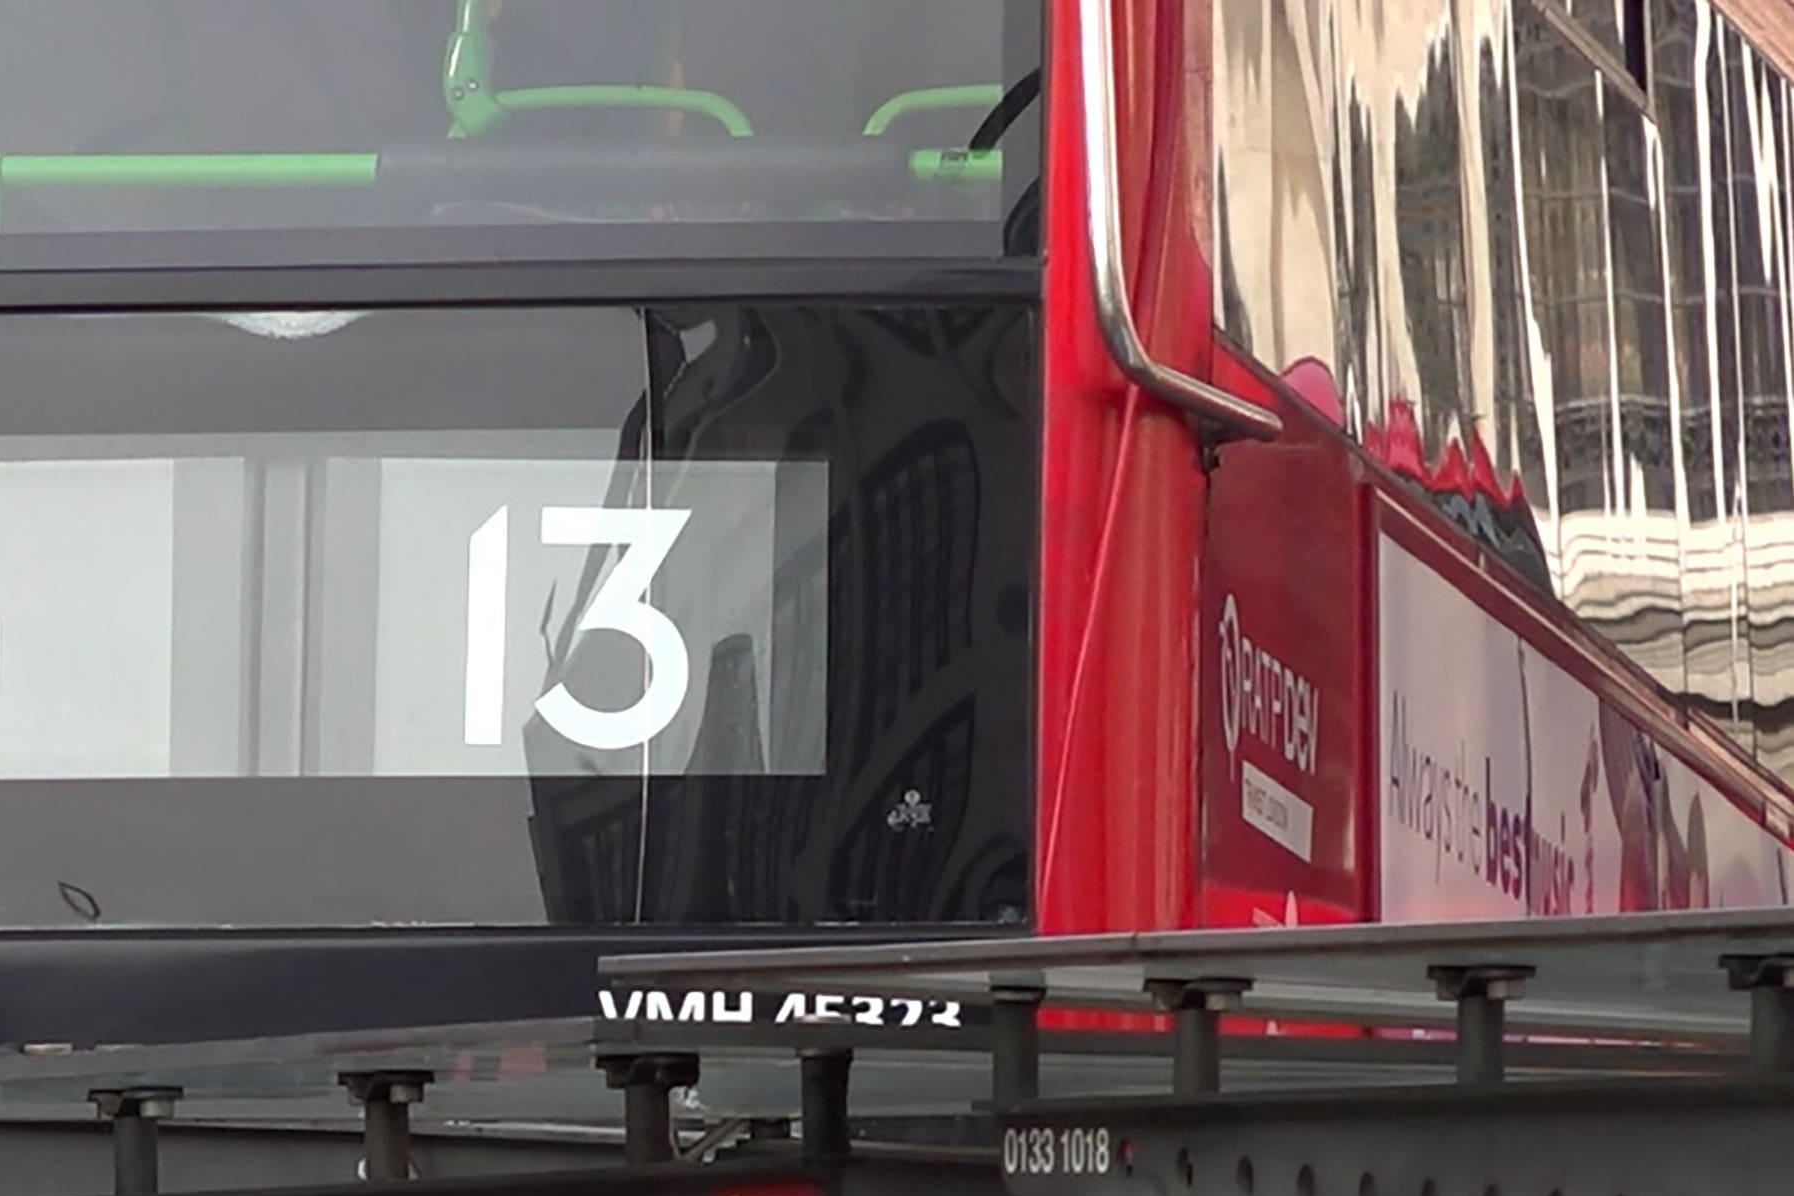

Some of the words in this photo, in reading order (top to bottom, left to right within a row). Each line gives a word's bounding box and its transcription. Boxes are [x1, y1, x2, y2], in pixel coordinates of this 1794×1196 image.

[464, 504, 692, 750] 13
[1485, 757, 1533, 904] best
[1004, 1127, 1054, 1173] 0133
[1060, 1127, 1109, 1173] 1018
